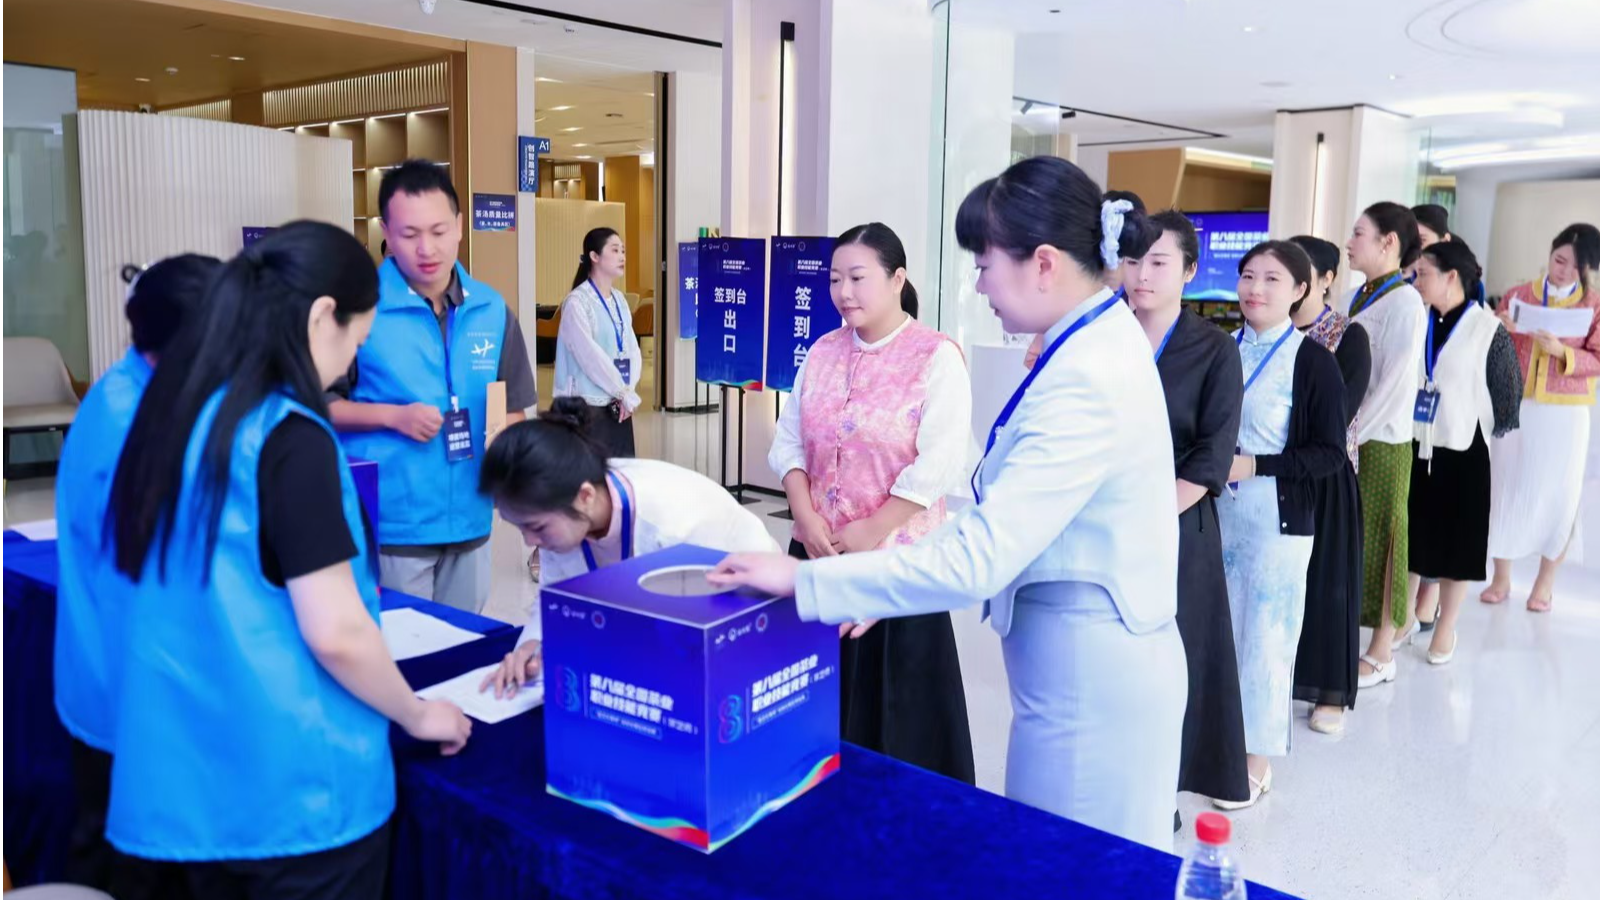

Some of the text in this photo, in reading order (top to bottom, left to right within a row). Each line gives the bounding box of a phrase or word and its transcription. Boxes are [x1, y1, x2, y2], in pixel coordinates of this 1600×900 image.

[539, 140, 550, 152] A1
[714, 287, 747, 305] 签到台
[723, 309, 737, 353] 出口
[794, 286, 812, 368] 签到台
